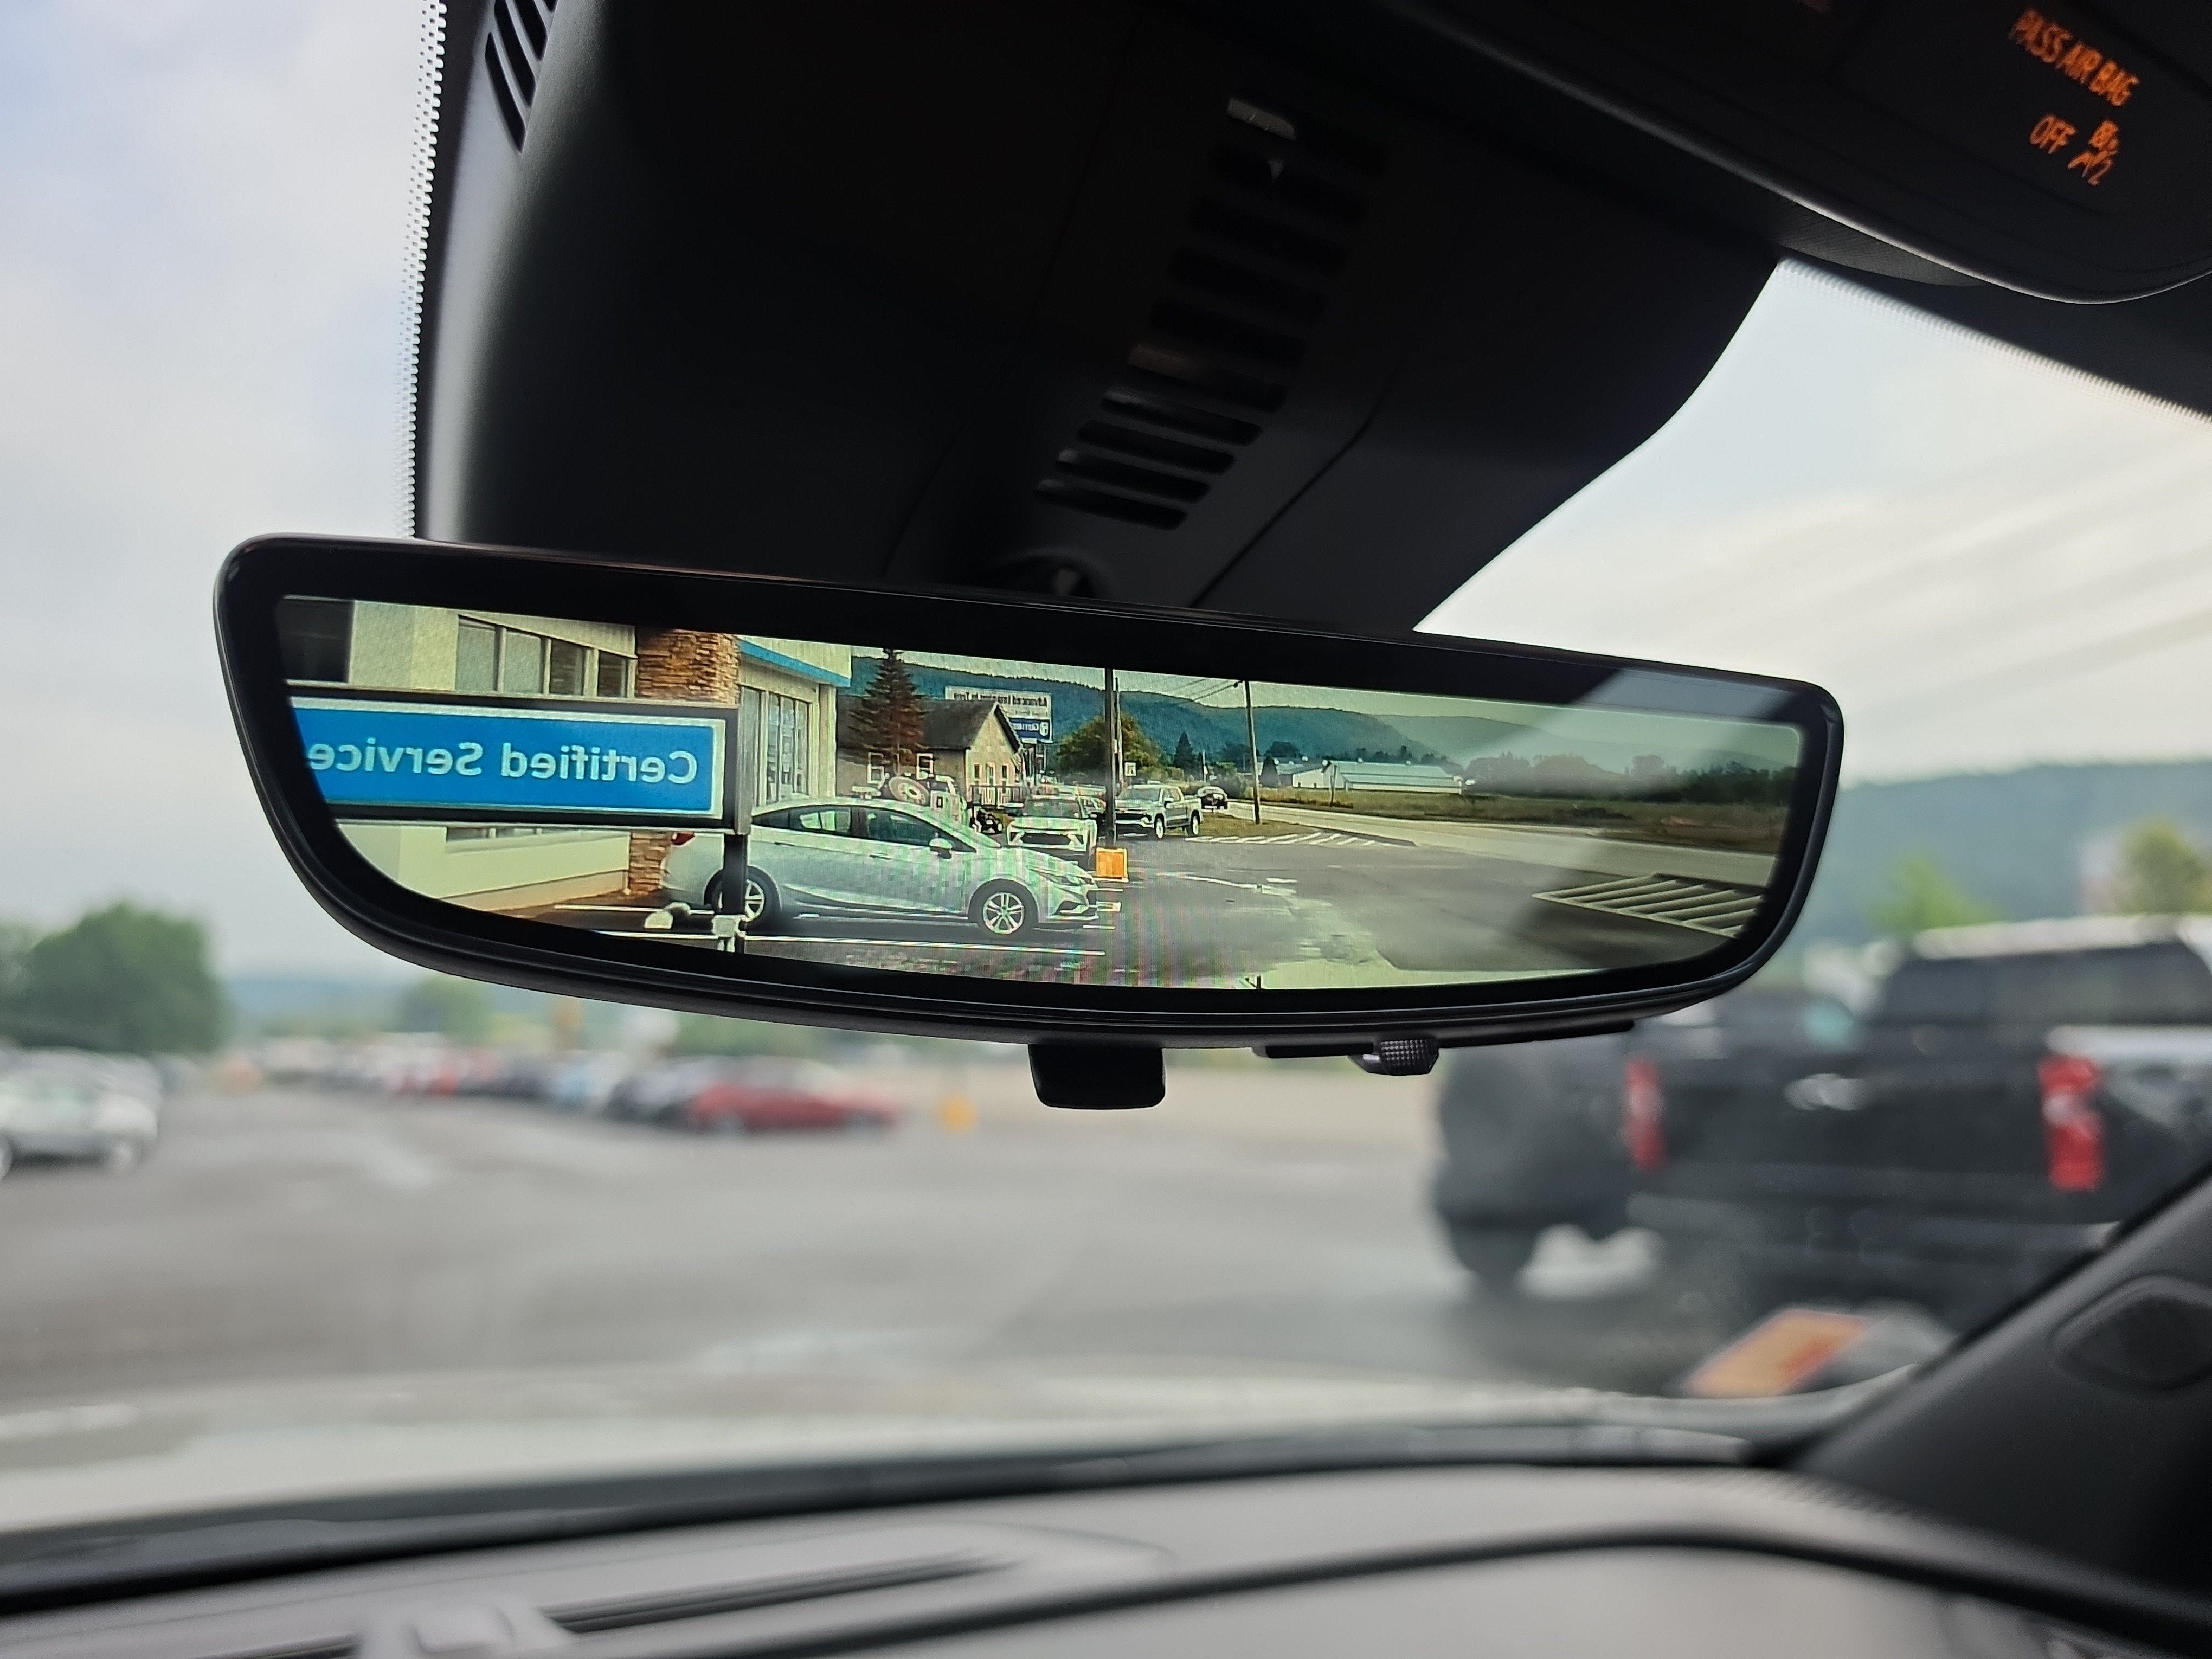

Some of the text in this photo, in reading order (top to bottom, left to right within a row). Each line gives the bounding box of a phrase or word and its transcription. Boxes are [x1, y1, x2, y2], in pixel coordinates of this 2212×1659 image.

[2008, 9, 2139, 106] PASS AIR BAG
[2030, 116, 2076, 154] OFF
